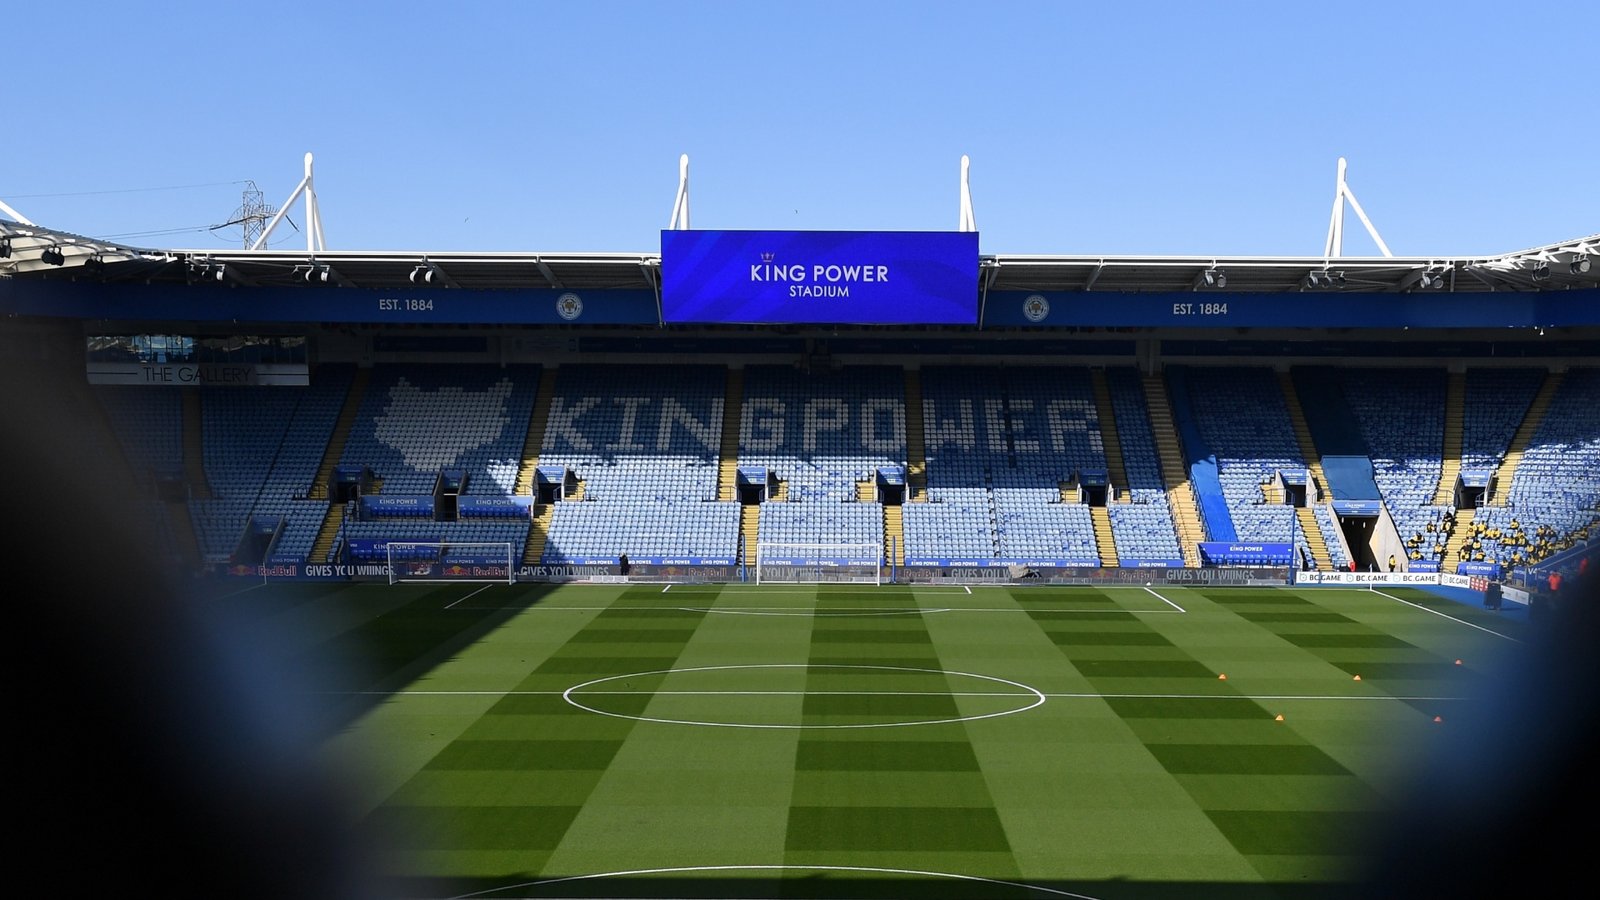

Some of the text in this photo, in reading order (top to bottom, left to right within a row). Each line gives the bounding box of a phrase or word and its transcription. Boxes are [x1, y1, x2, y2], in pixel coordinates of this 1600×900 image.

[751, 265, 889, 282] KING POWER
[789, 285, 850, 298] STADIUM
[379, 299, 434, 311] EST. 1884
[1173, 303, 1228, 315] EST. 1884
[143, 366, 251, 382] THE GALLERY
[305, 564, 333, 577] GIVES
[521, 566, 547, 576] GIVES
[549, 566, 570, 576] YOU
[951, 568, 978, 578] GIVES
[980, 568, 1000, 578] YOU
[1166, 569, 1192, 580] GIVES
[1195, 569, 1214, 580] YOU
